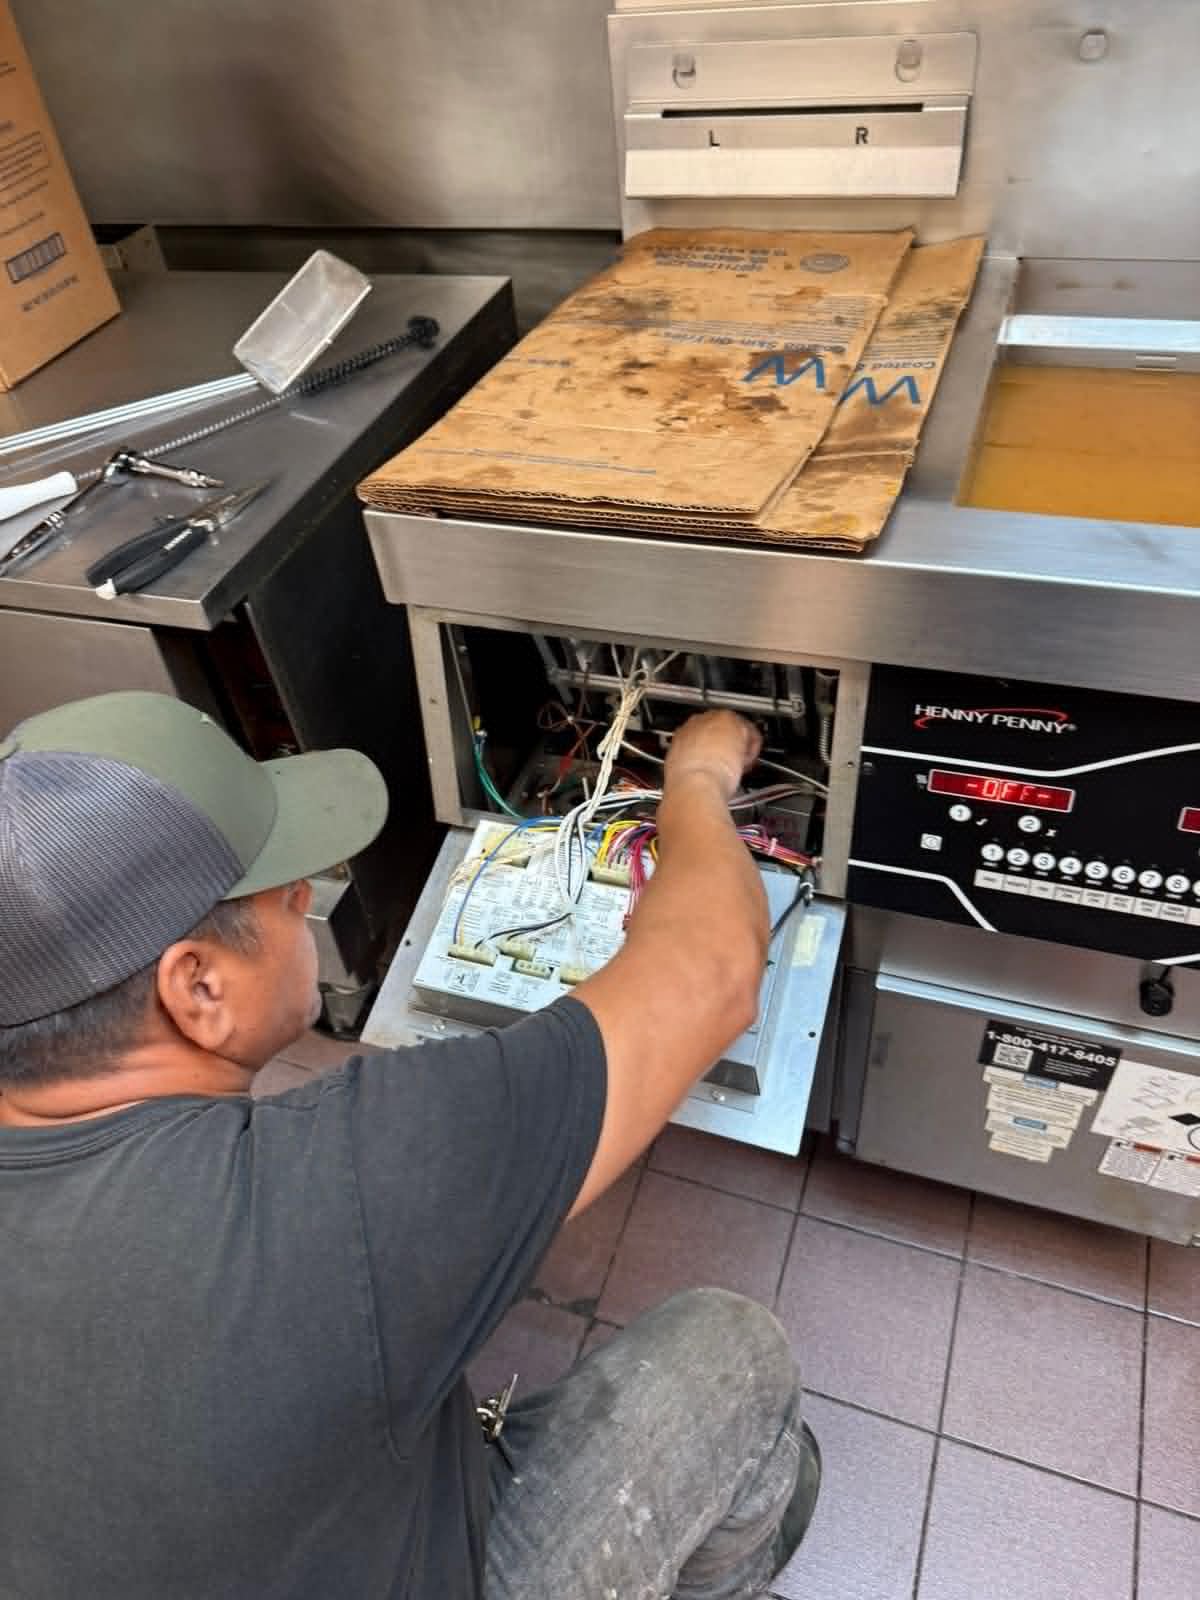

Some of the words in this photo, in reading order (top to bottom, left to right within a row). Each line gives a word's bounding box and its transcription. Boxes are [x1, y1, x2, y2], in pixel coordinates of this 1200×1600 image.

[708, 129, 721, 147] L
[855, 126, 869, 145] R
[914, 704, 990, 724] HENNY
[987, 1031, 1117, 1066] 1-800-417-8405
